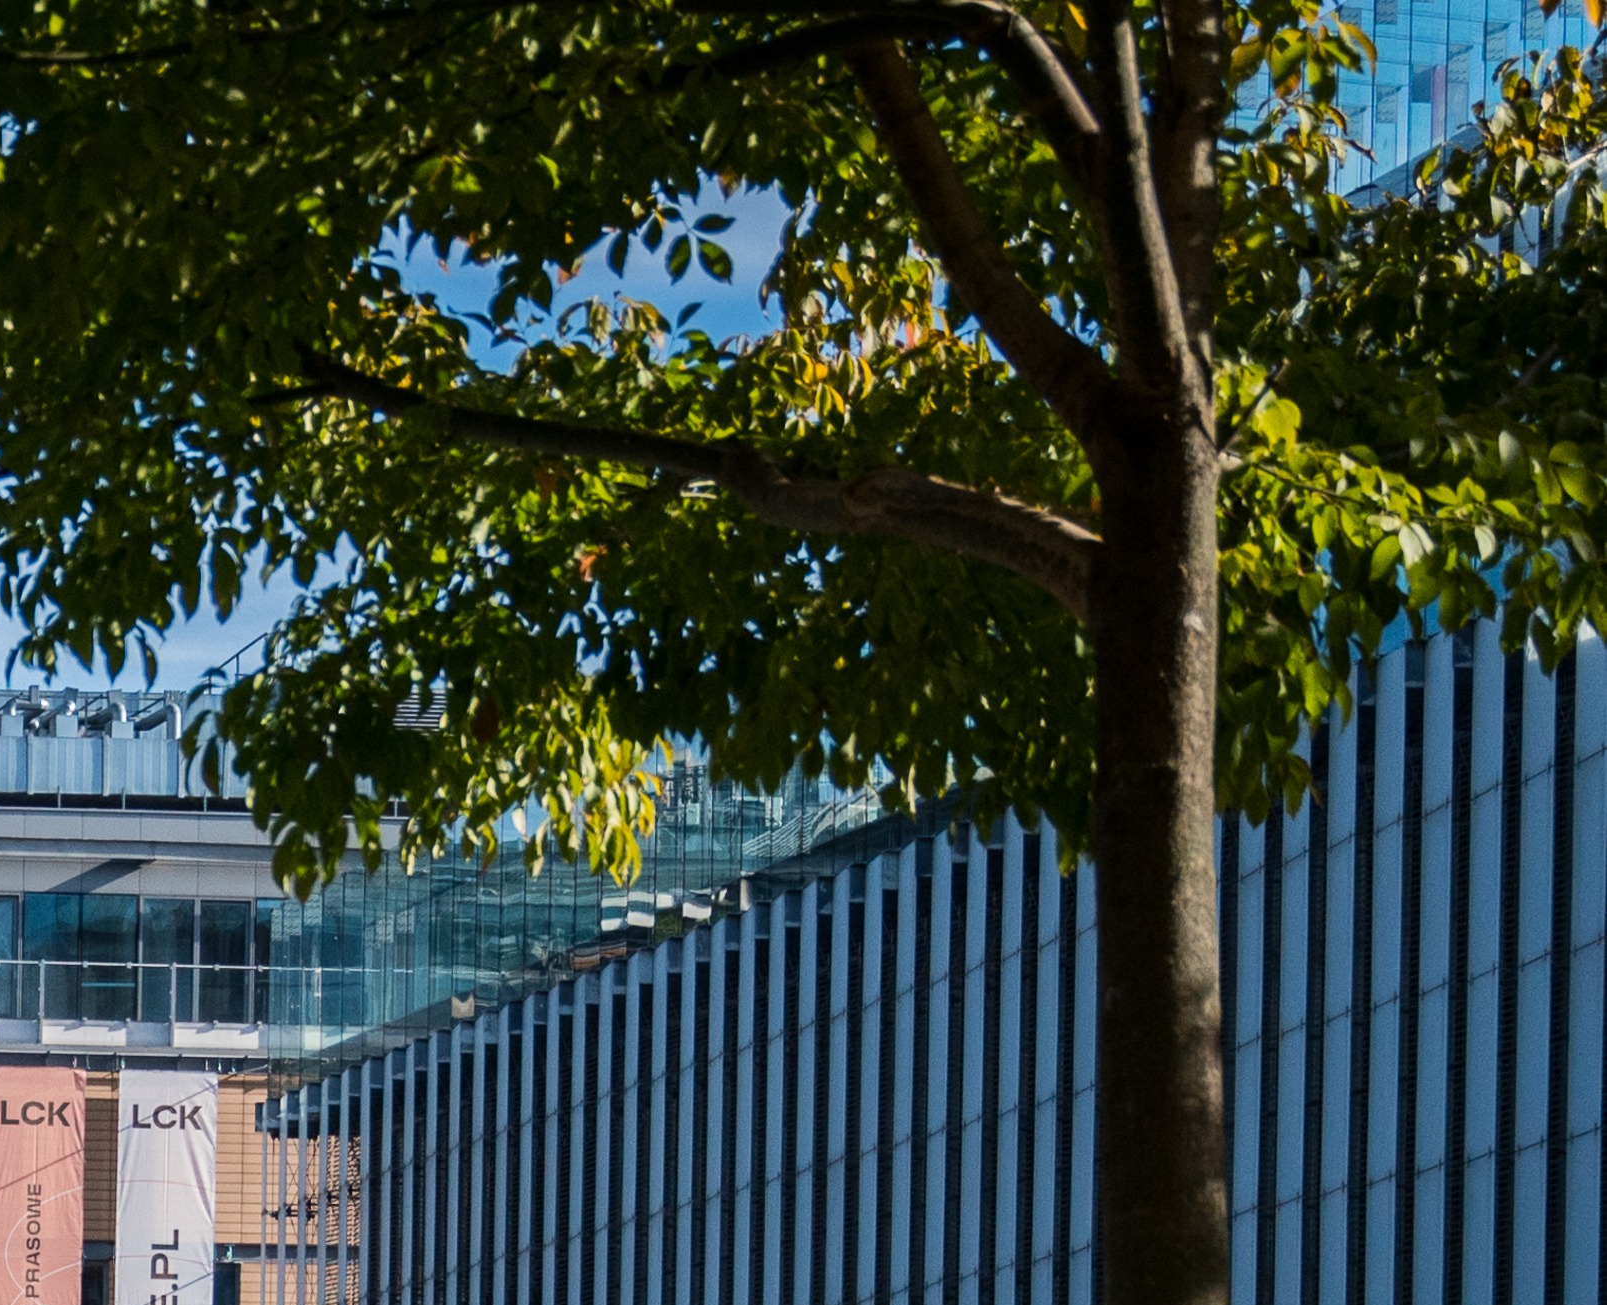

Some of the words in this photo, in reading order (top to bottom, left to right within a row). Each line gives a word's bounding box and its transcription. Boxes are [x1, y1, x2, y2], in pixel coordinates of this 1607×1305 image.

[0, 1100, 70, 1127] LCK
[132, 1104, 202, 1130] LCK
[25, 1184, 42, 1299] PRASOWE
